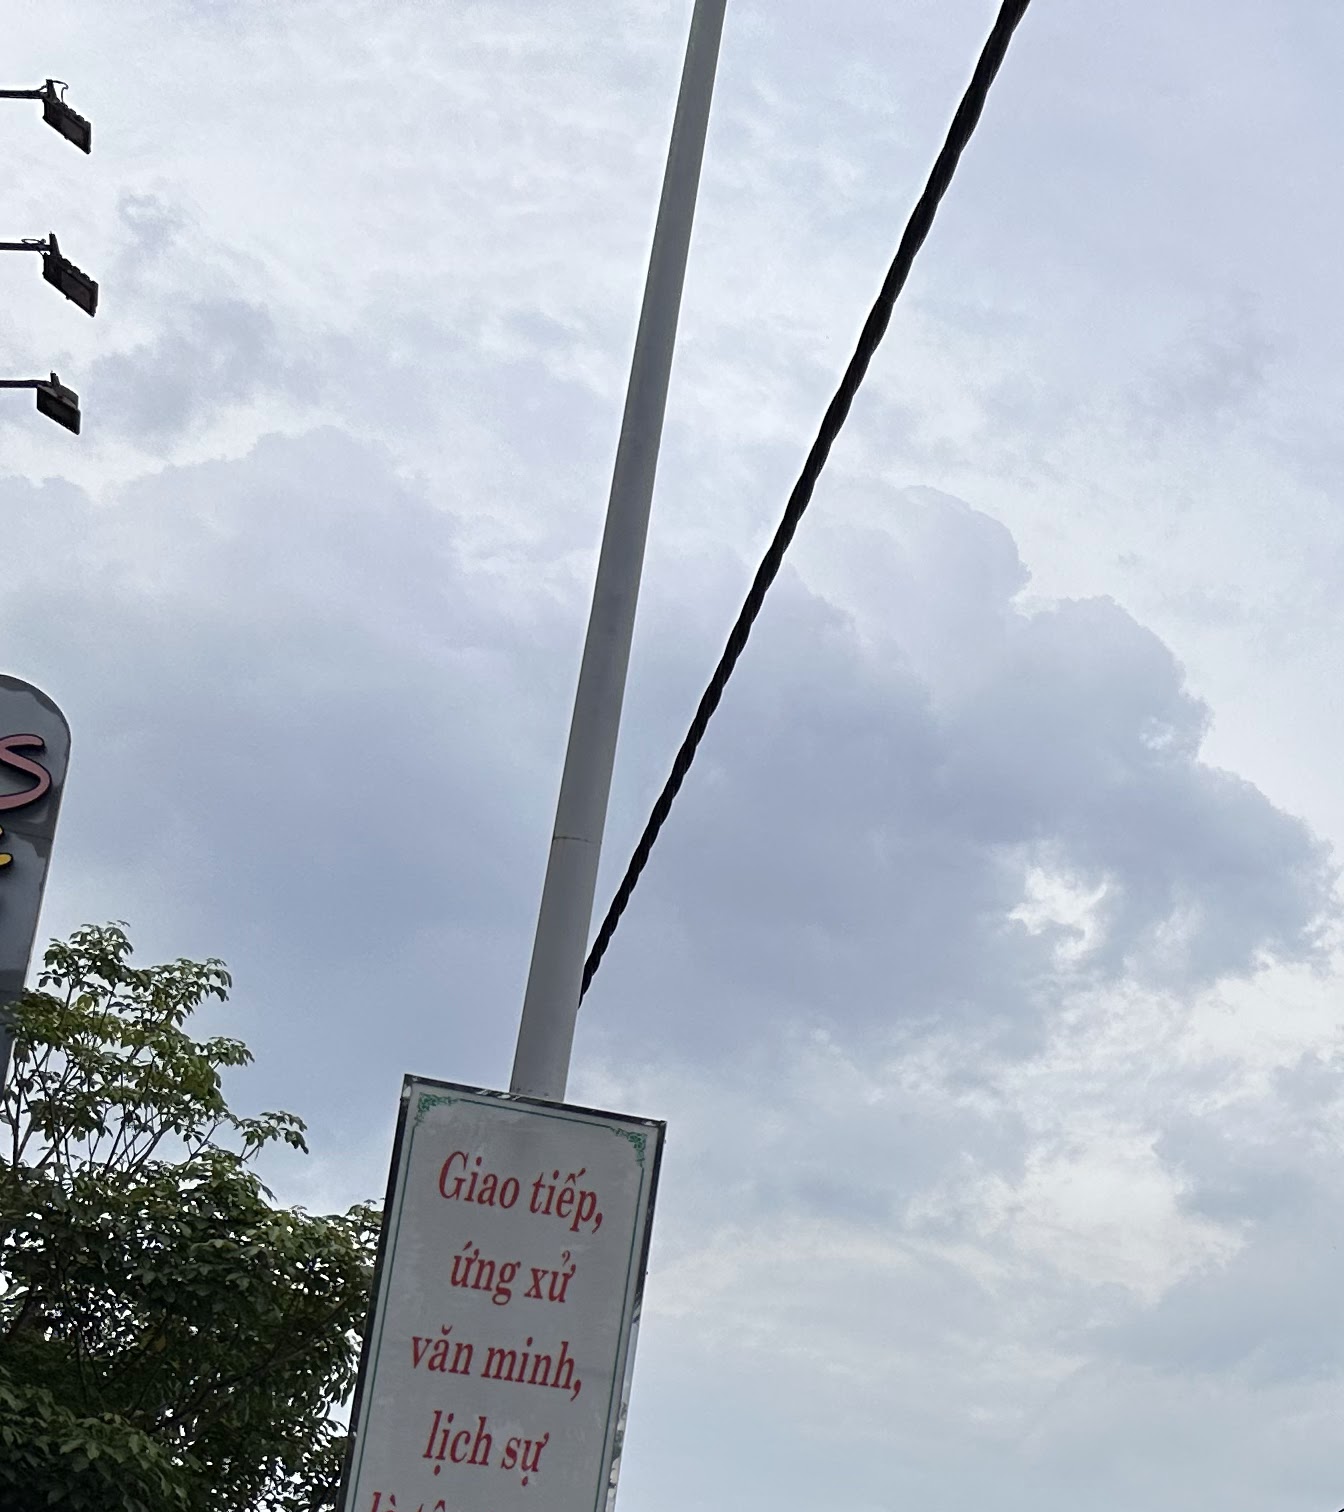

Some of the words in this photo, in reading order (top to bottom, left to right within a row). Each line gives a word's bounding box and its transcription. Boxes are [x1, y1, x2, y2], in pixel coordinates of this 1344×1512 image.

[438, 1150, 521, 1210] Giao
[529, 1168, 604, 1235] tiếp,
[450, 1240, 522, 1306] ứng
[524, 1250, 577, 1304] xử
[411, 1324, 474, 1376] văn
[480, 1336, 583, 1402] minh,
[422, 1410, 493, 1476] lịch
[501, 1431, 550, 1487] sự
